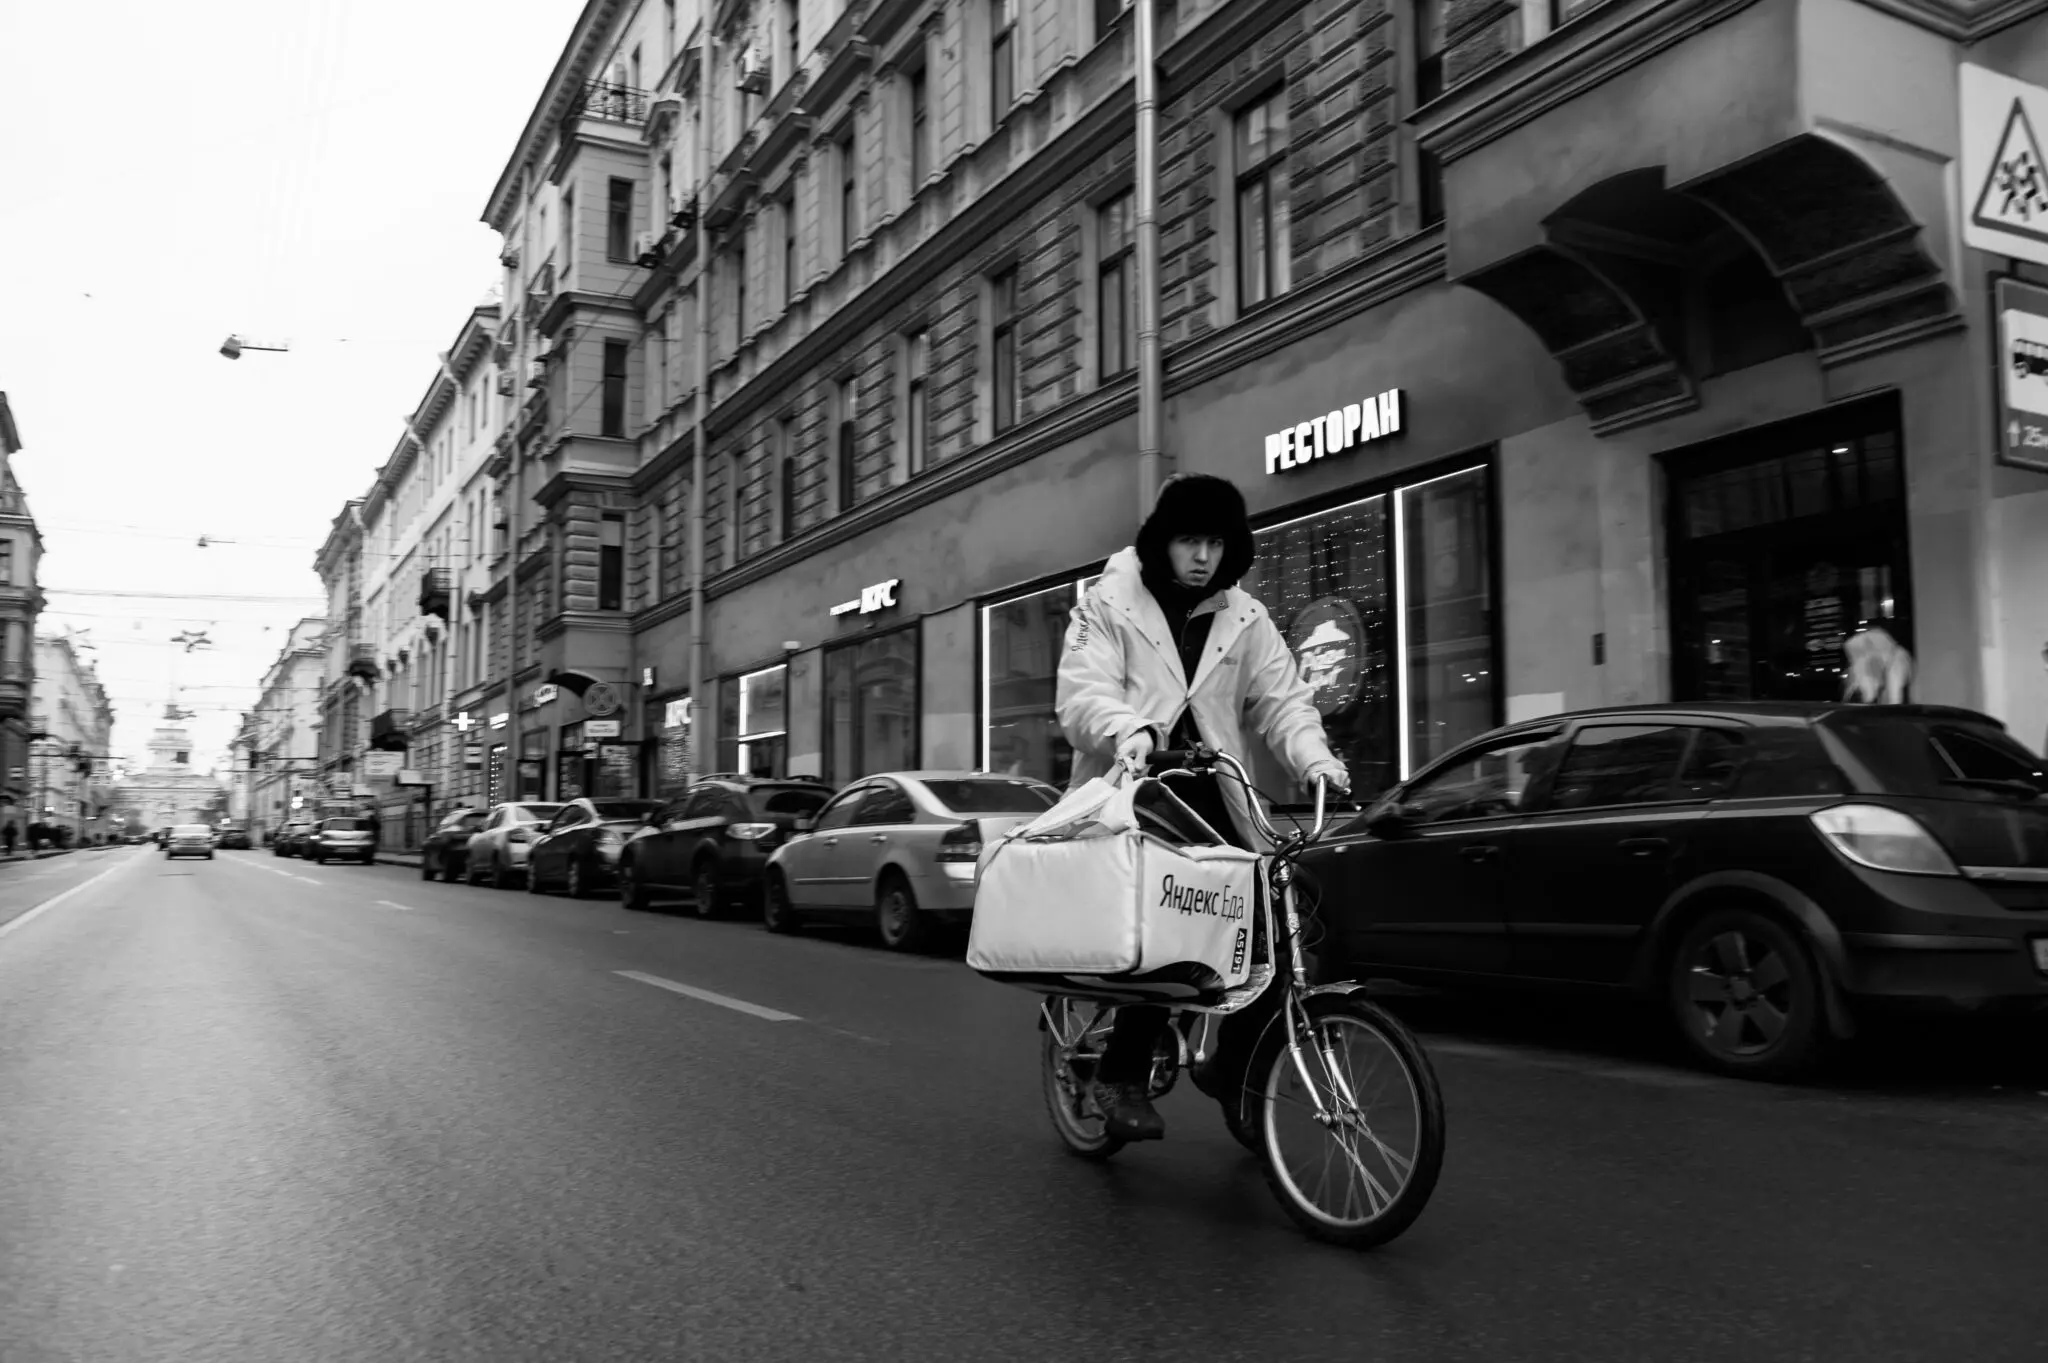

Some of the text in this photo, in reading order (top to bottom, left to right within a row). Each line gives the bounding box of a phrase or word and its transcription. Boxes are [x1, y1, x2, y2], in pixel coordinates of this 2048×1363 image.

[1265, 388, 1400, 475] РЕСТОРАН
[1160, 874, 1244, 922] Яндекс Еда
[1232, 930, 1246, 972] A5191
